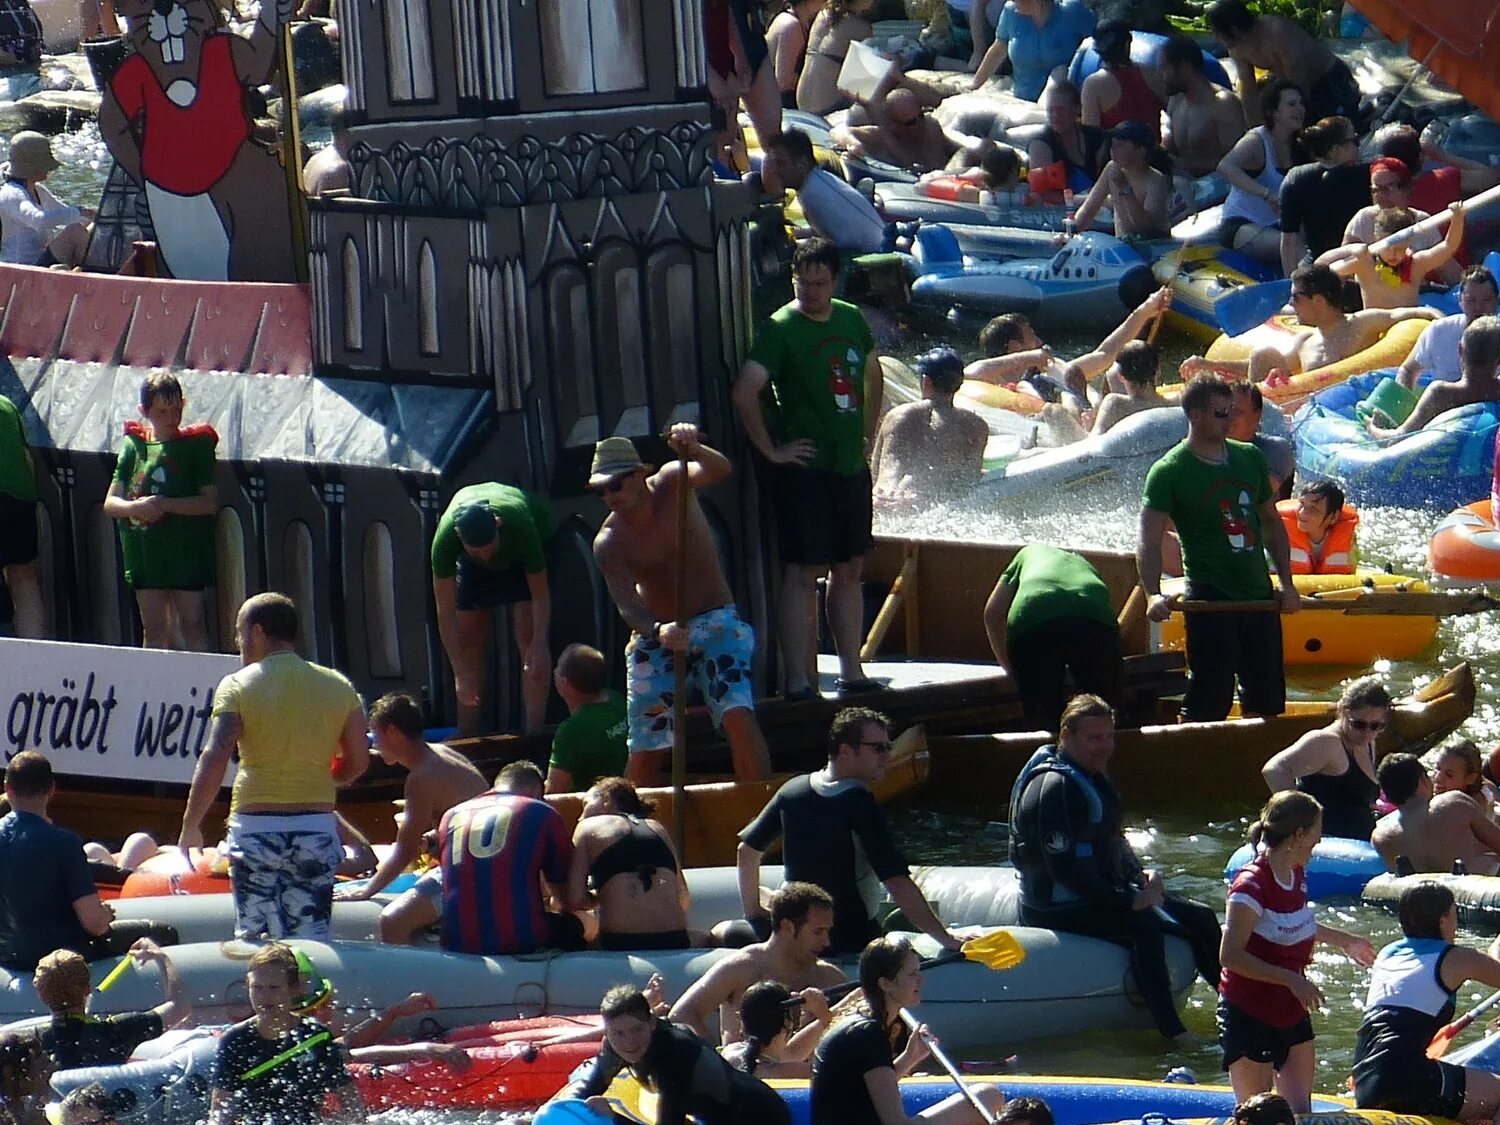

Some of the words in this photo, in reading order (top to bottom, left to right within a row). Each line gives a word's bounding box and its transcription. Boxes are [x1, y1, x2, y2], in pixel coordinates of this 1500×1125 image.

[4, 671, 118, 763] gräbt
[133, 686, 214, 759] weit
[445, 805, 514, 866] 10
